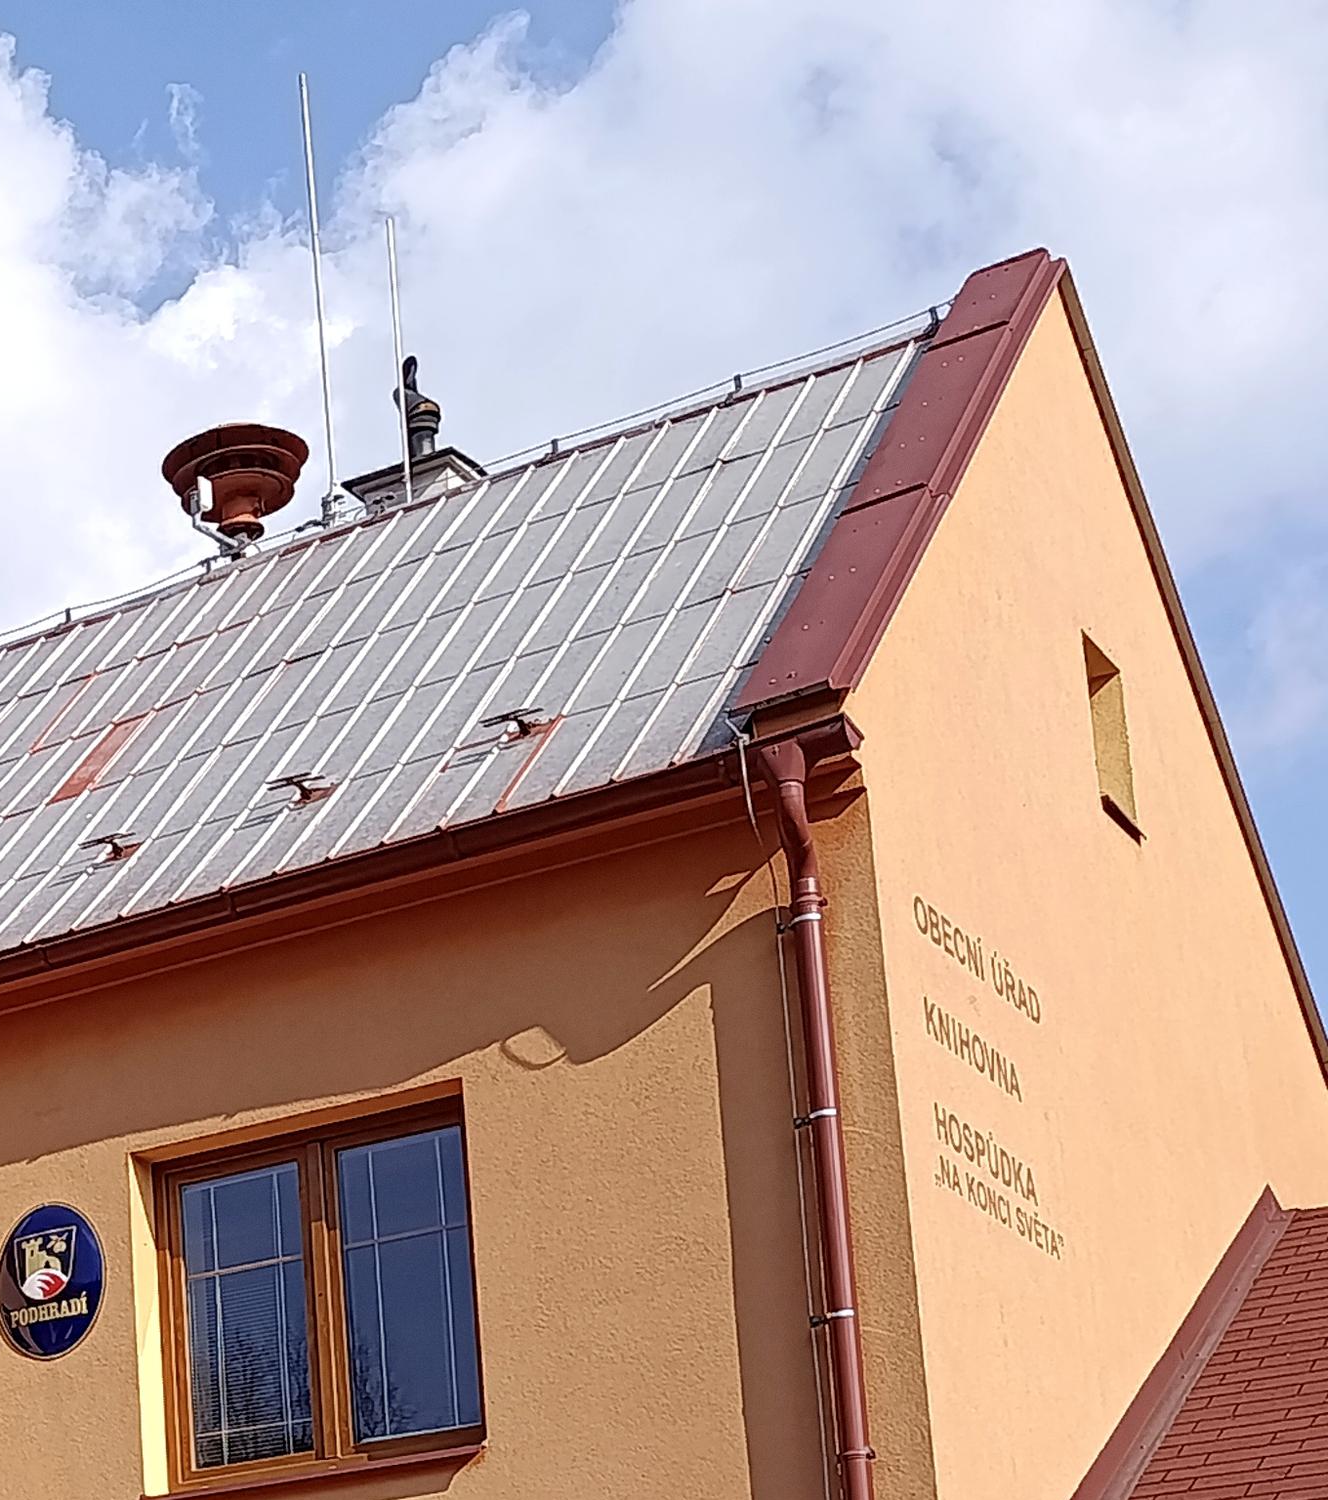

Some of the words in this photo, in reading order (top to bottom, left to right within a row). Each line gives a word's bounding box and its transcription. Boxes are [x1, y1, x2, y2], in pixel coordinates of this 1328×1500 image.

[913, 896, 985, 982] OBECNÍ
[991, 951, 1041, 1024] ÚŘAD
[923, 996, 1022, 1102] KNIHOVNA
[934, 1102, 1038, 1206] HOSPŮDKA
[966, 1172, 1012, 1229] KONCI
[10, 1292, 89, 1328] PODHRADÍ
